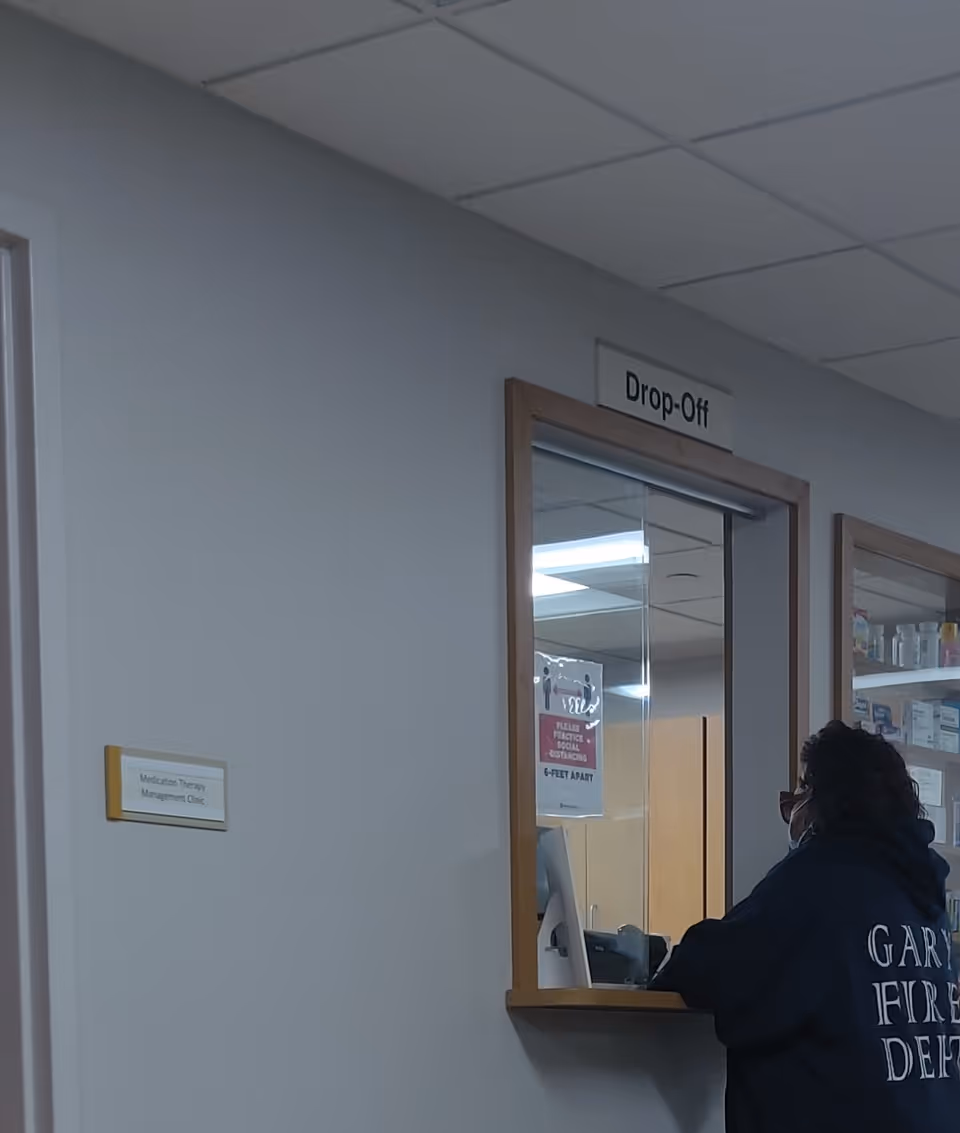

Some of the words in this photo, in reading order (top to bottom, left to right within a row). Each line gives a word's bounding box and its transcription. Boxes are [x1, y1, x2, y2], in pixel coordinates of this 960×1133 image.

[626, 370, 709, 429] Drop-Off
[553, 730, 584, 743] PRACTICE
[557, 741, 580, 752] SOCIAL
[140, 773, 177, 786] Medication
[178, 778, 206, 792] Therapy
[544, 768, 568, 779] 6-FEET
[570, 771, 593, 783] APART
[141, 788, 186, 802] Management
[187, 794, 206, 805] Clinic
[868, 923, 953, 971] GARY
